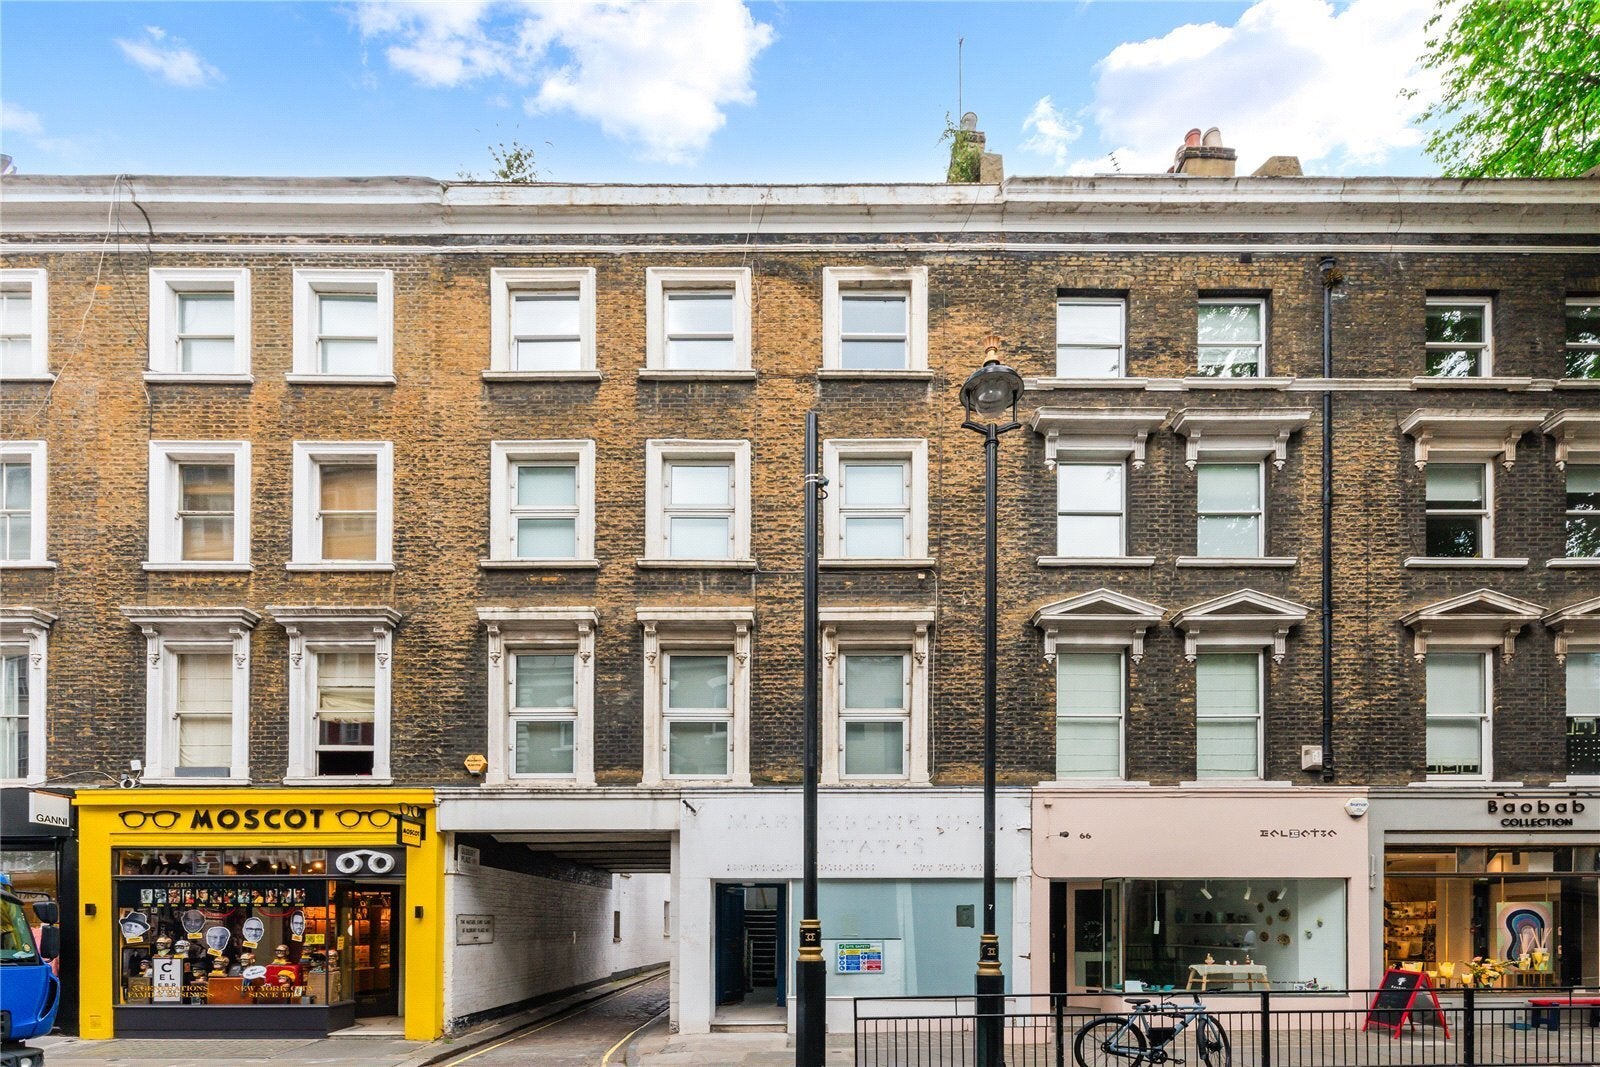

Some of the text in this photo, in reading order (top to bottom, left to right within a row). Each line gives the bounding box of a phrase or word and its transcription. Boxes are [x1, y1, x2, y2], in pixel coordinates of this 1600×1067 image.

[1487, 799, 1585, 814] Baobab
[36, 813, 68, 826] GANNI
[190, 808, 324, 830] MOSCOT
[1500, 818, 1574, 827] COLLECTION
[403, 828, 420, 837] MOSCOT
[161, 962, 172, 973] C
